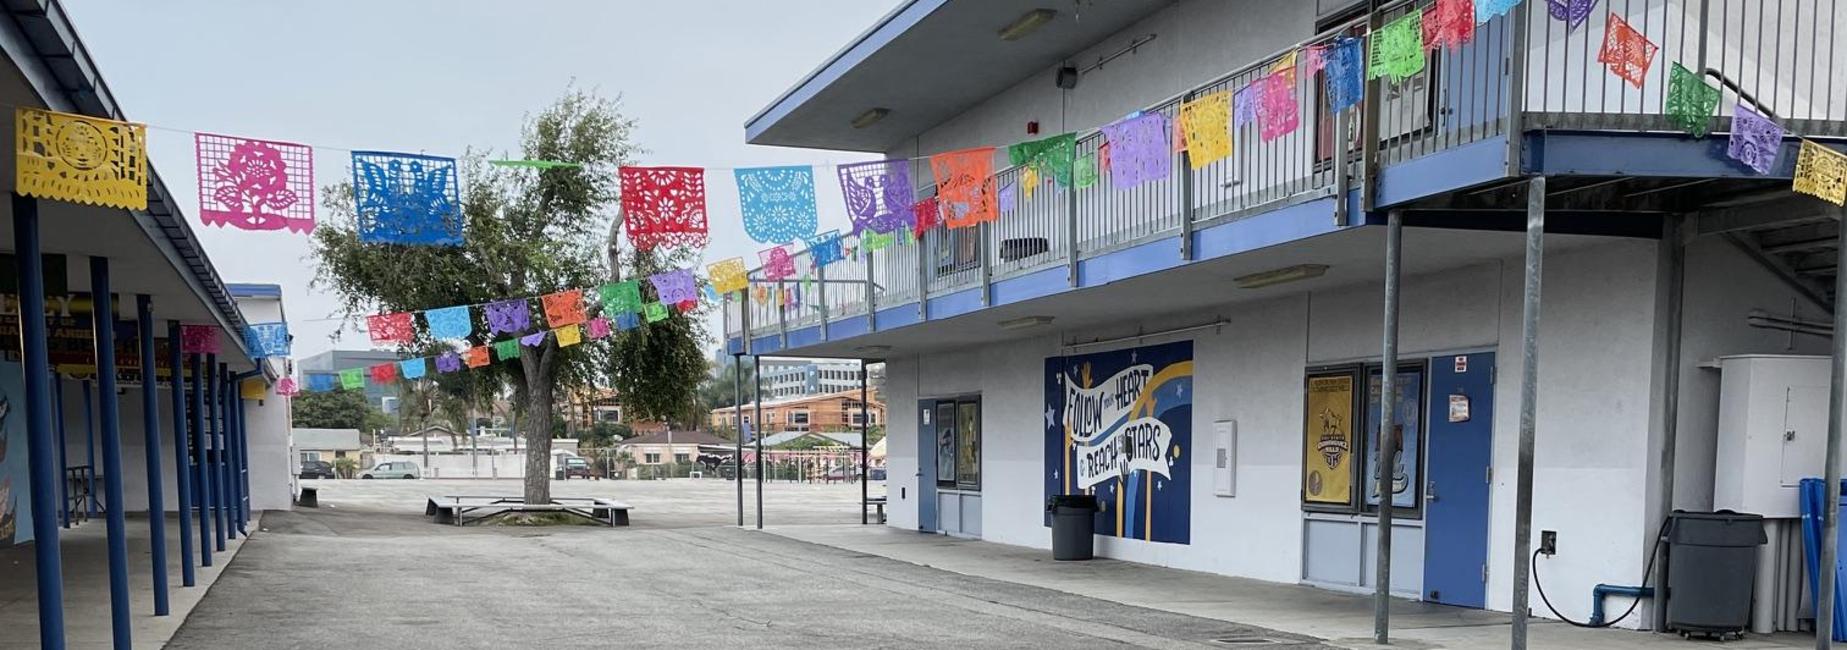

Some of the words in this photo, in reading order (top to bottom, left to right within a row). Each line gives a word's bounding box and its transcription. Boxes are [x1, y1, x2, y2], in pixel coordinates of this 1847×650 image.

[1067, 388, 1104, 437] FOLLOW
[1115, 370, 1149, 410] HEART
[1087, 437, 1118, 478] REACH
[1124, 423, 1160, 461] STARS
